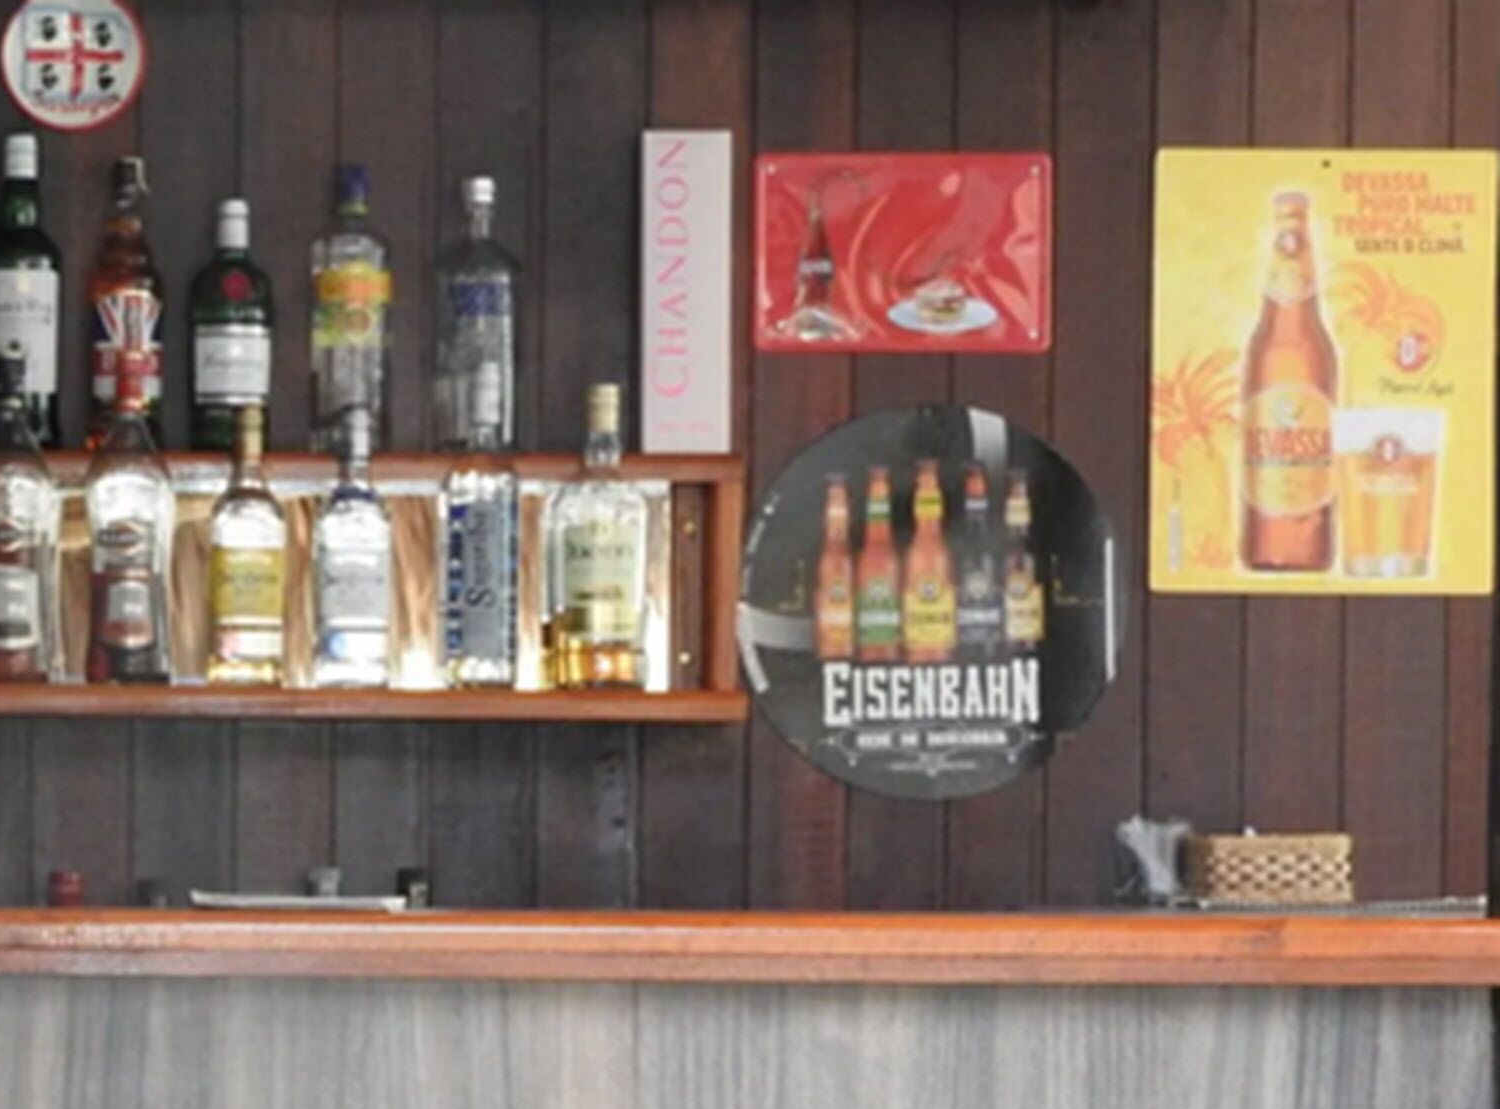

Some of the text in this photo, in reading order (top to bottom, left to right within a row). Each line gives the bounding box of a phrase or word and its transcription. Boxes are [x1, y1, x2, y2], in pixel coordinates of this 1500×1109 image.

[1342, 171, 1429, 191] DEVASSA
[1414, 192, 1476, 214] MALTE
[651, 138, 691, 398] CHANDON
[823, 658, 1040, 726] EISENBAHN
